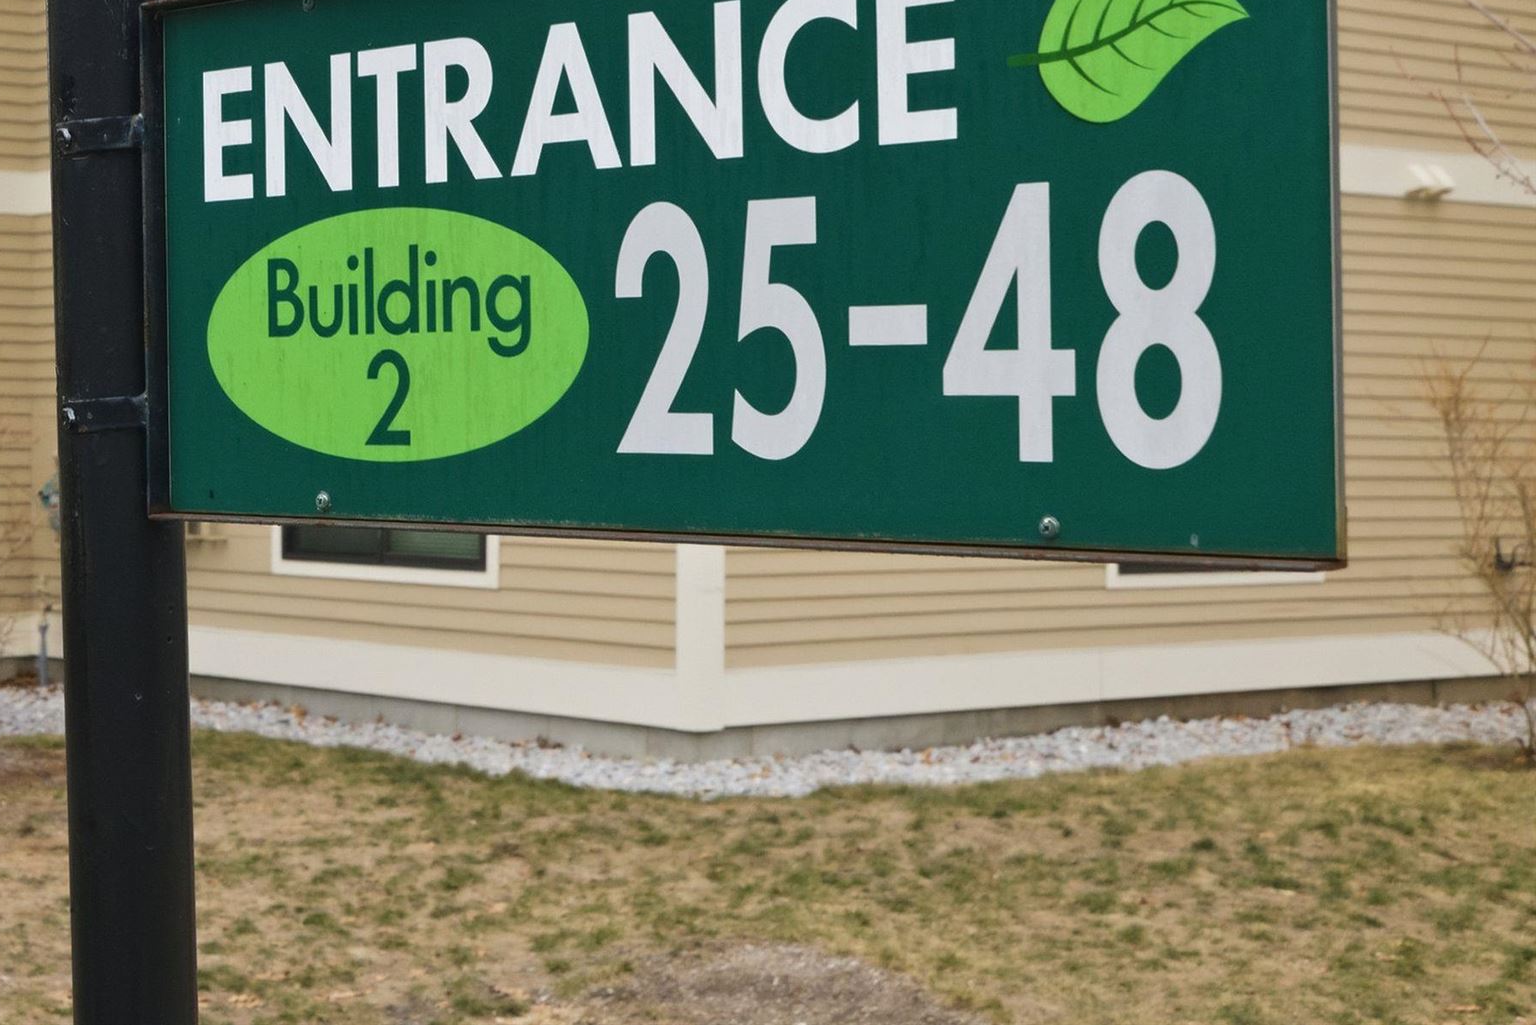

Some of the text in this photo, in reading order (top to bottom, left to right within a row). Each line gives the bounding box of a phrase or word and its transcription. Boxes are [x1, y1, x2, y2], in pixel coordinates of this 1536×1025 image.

[267, 245, 532, 358] Building
[615, 169, 1222, 470] 25-48
[364, 348, 412, 447] 2
